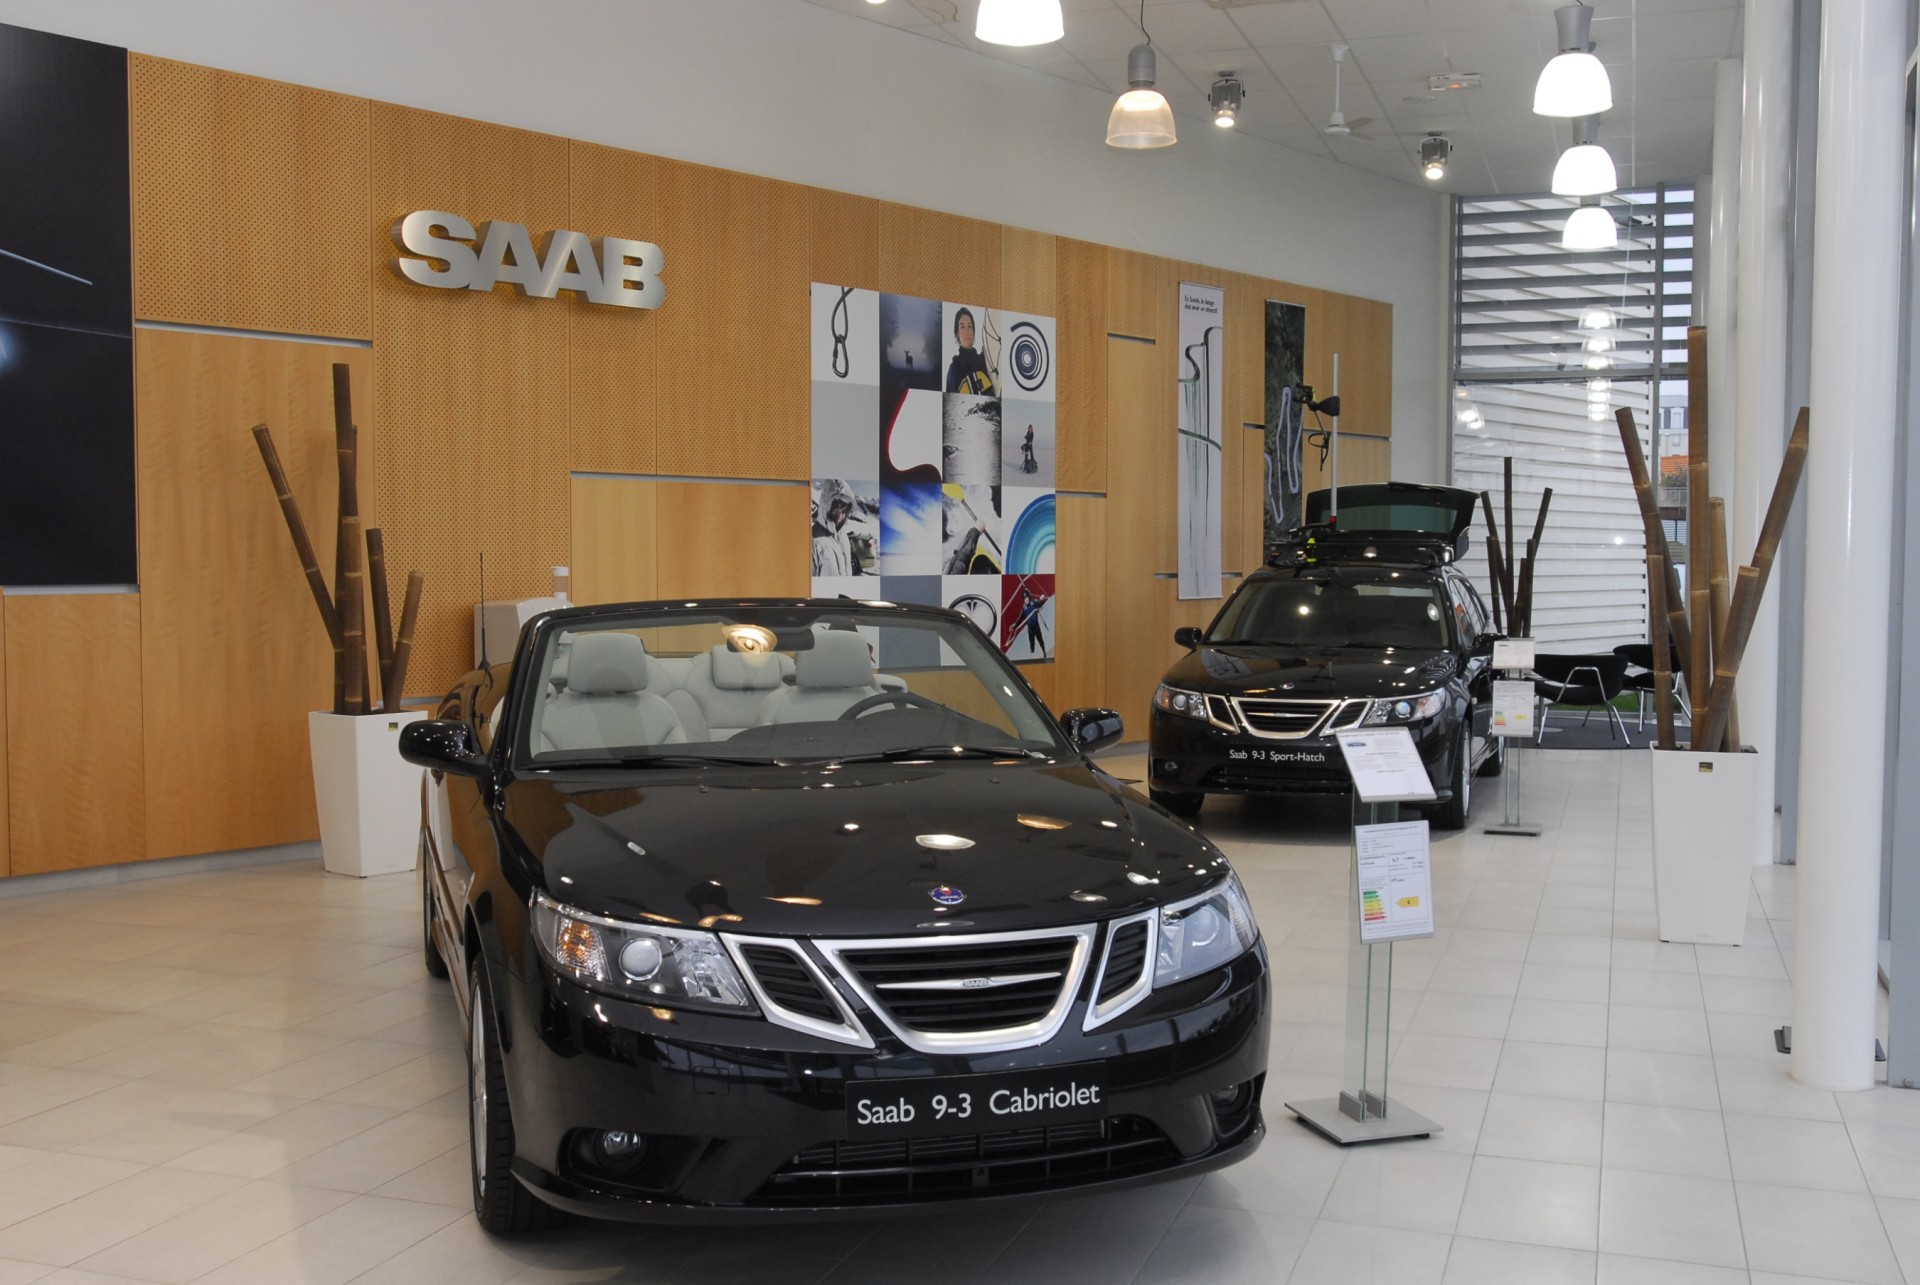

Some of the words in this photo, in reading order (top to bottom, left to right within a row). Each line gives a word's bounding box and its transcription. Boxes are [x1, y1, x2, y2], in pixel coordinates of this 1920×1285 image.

[390, 209, 666, 311] SAAB
[1229, 749, 1248, 759] Saab
[1252, 750, 1265, 760] 9-3
[1270, 751, 1325, 763] Sport-Hatch
[857, 1098, 915, 1125] Saab
[931, 1093, 972, 1120] 9-3
[989, 1081, 1100, 1115] Cabriolet
